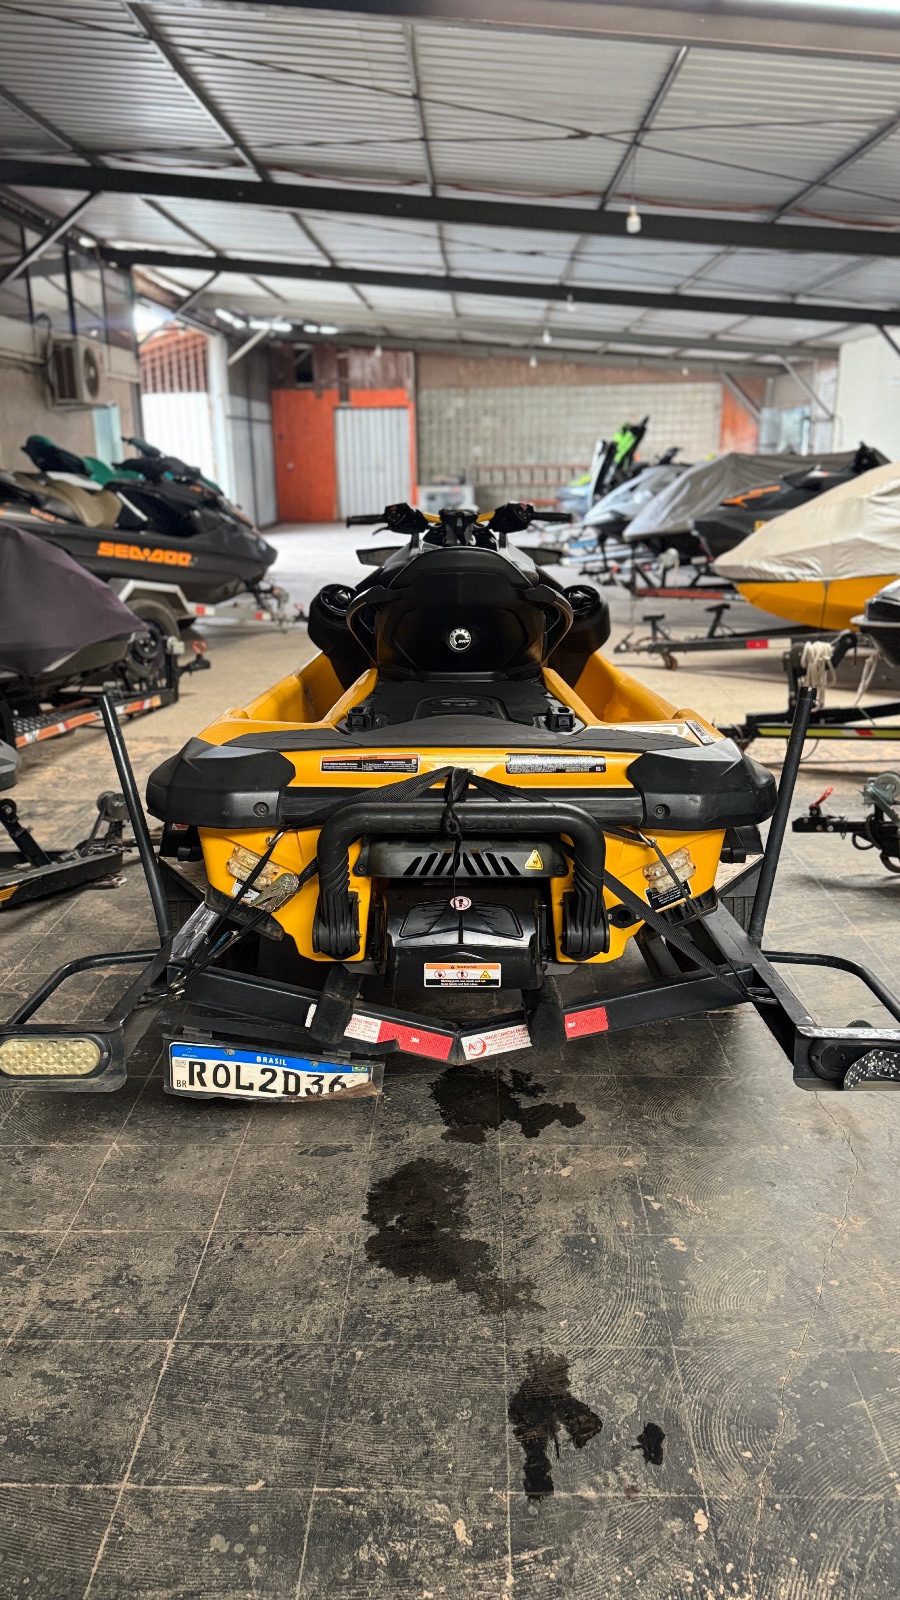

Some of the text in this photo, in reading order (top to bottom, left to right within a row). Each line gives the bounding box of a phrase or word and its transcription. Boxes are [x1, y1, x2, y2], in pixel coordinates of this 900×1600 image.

[256, 1055, 288, 1066] BRASIL
[176, 1079, 187, 1088] BR
[188, 1061, 347, 1096] ROL2D36
